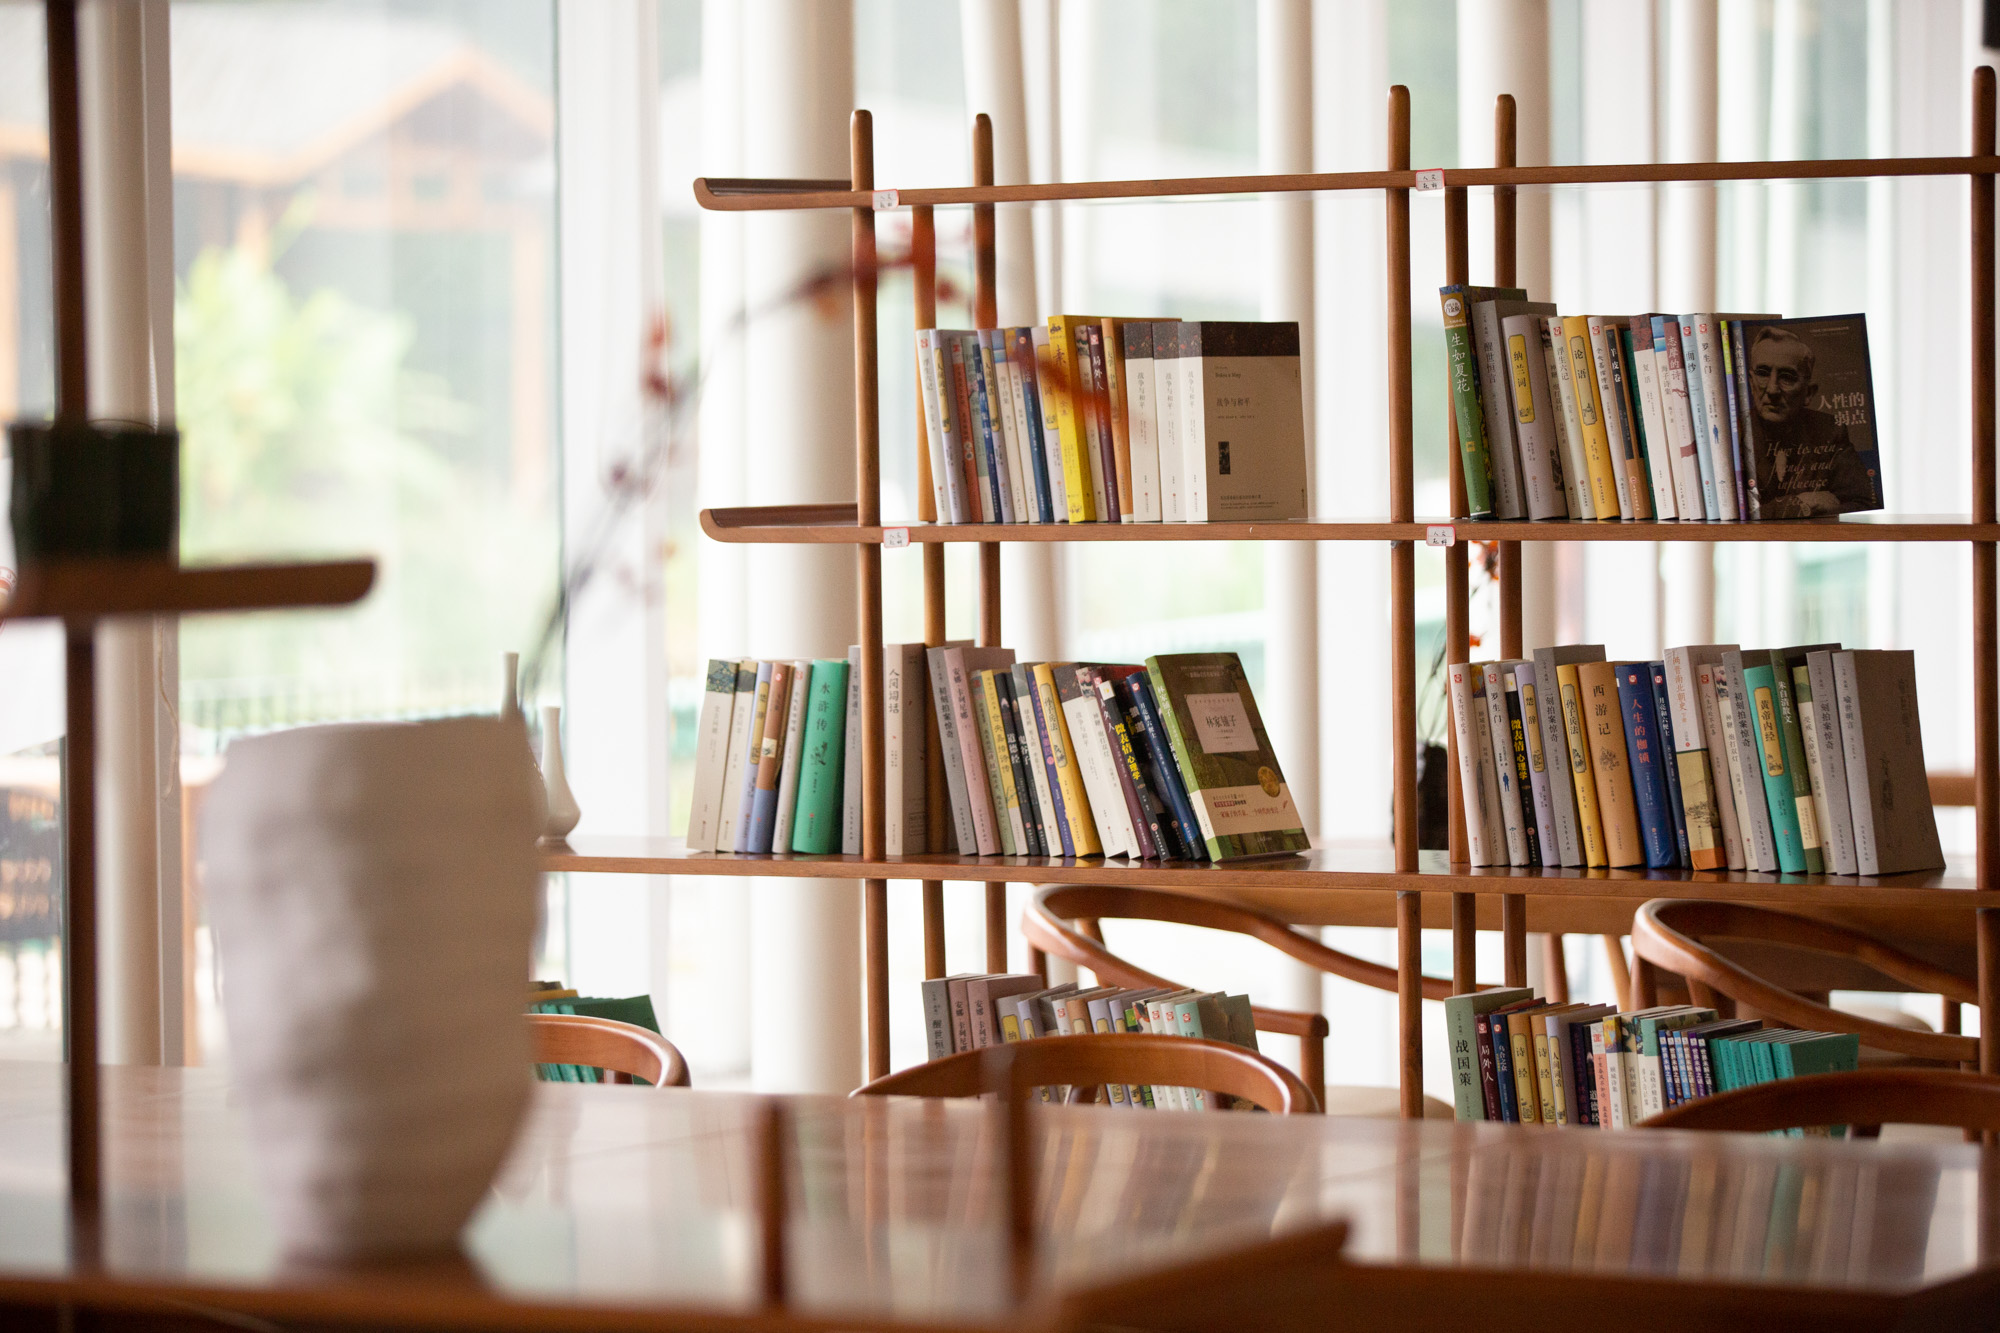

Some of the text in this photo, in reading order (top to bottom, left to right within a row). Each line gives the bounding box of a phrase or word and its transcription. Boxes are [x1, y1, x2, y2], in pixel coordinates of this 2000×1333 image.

[1092, 355, 1105, 391] 局外人
[1451, 332, 1470, 393] 生如夏花
[1484, 342, 1497, 383] 醒世恒言
[1513, 351, 1527, 387] 纳兰词
[1557, 347, 1570, 380] 浮生六记
[1574, 349, 1586, 379] 论语
[1667, 335, 1682, 381] 志摩的诗
[1702, 342, 1712, 374] 罗生门
[1735, 341, 1746, 384] 人性的弱点
[1137, 372, 1147, 409] 战争与和平
[1165, 372, 1173, 410] 战争与和平
[1187, 371, 1195, 409] 战争与和平
[1216, 397, 1250, 407] 战争与和平
[1817, 392, 1865, 411] 人性的
[1833, 411, 1867, 427] 弱点
[889, 669, 900, 714] 人间词话
[1157, 685, 1172, 717] 林家铺子
[1672, 656, 1687, 712] 两晋南北朝史
[1777, 681, 1793, 724] 朱自清散文
[816, 682, 831, 732] 水浒传
[1205, 715, 1237, 728] 林家铺子
[1490, 692, 1502, 724] 罗生门
[1525, 697, 1537, 725] 楚辞
[1544, 687, 1559, 743] 二刻拍案惊奇
[1565, 698, 1579, 736] 孙子兵法
[1593, 684, 1611, 736] 西游记
[1760, 700, 1776, 742] 黄帝内经
[1819, 694, 1835, 750] 二刻拍案惊奇
[1115, 722, 1141, 780] 微表情心理学
[1511, 719, 1528, 781] 微表情心理学
[1455, 1039, 1472, 1086] 战国策
[1481, 1045, 1494, 1082] 局外人
[1516, 1047, 1528, 1078] 诗经
[1538, 1047, 1550, 1078] 诗经
[1552, 1052, 1562, 1088] 人间词话
[1589, 1090, 1600, 1122] 道德经
